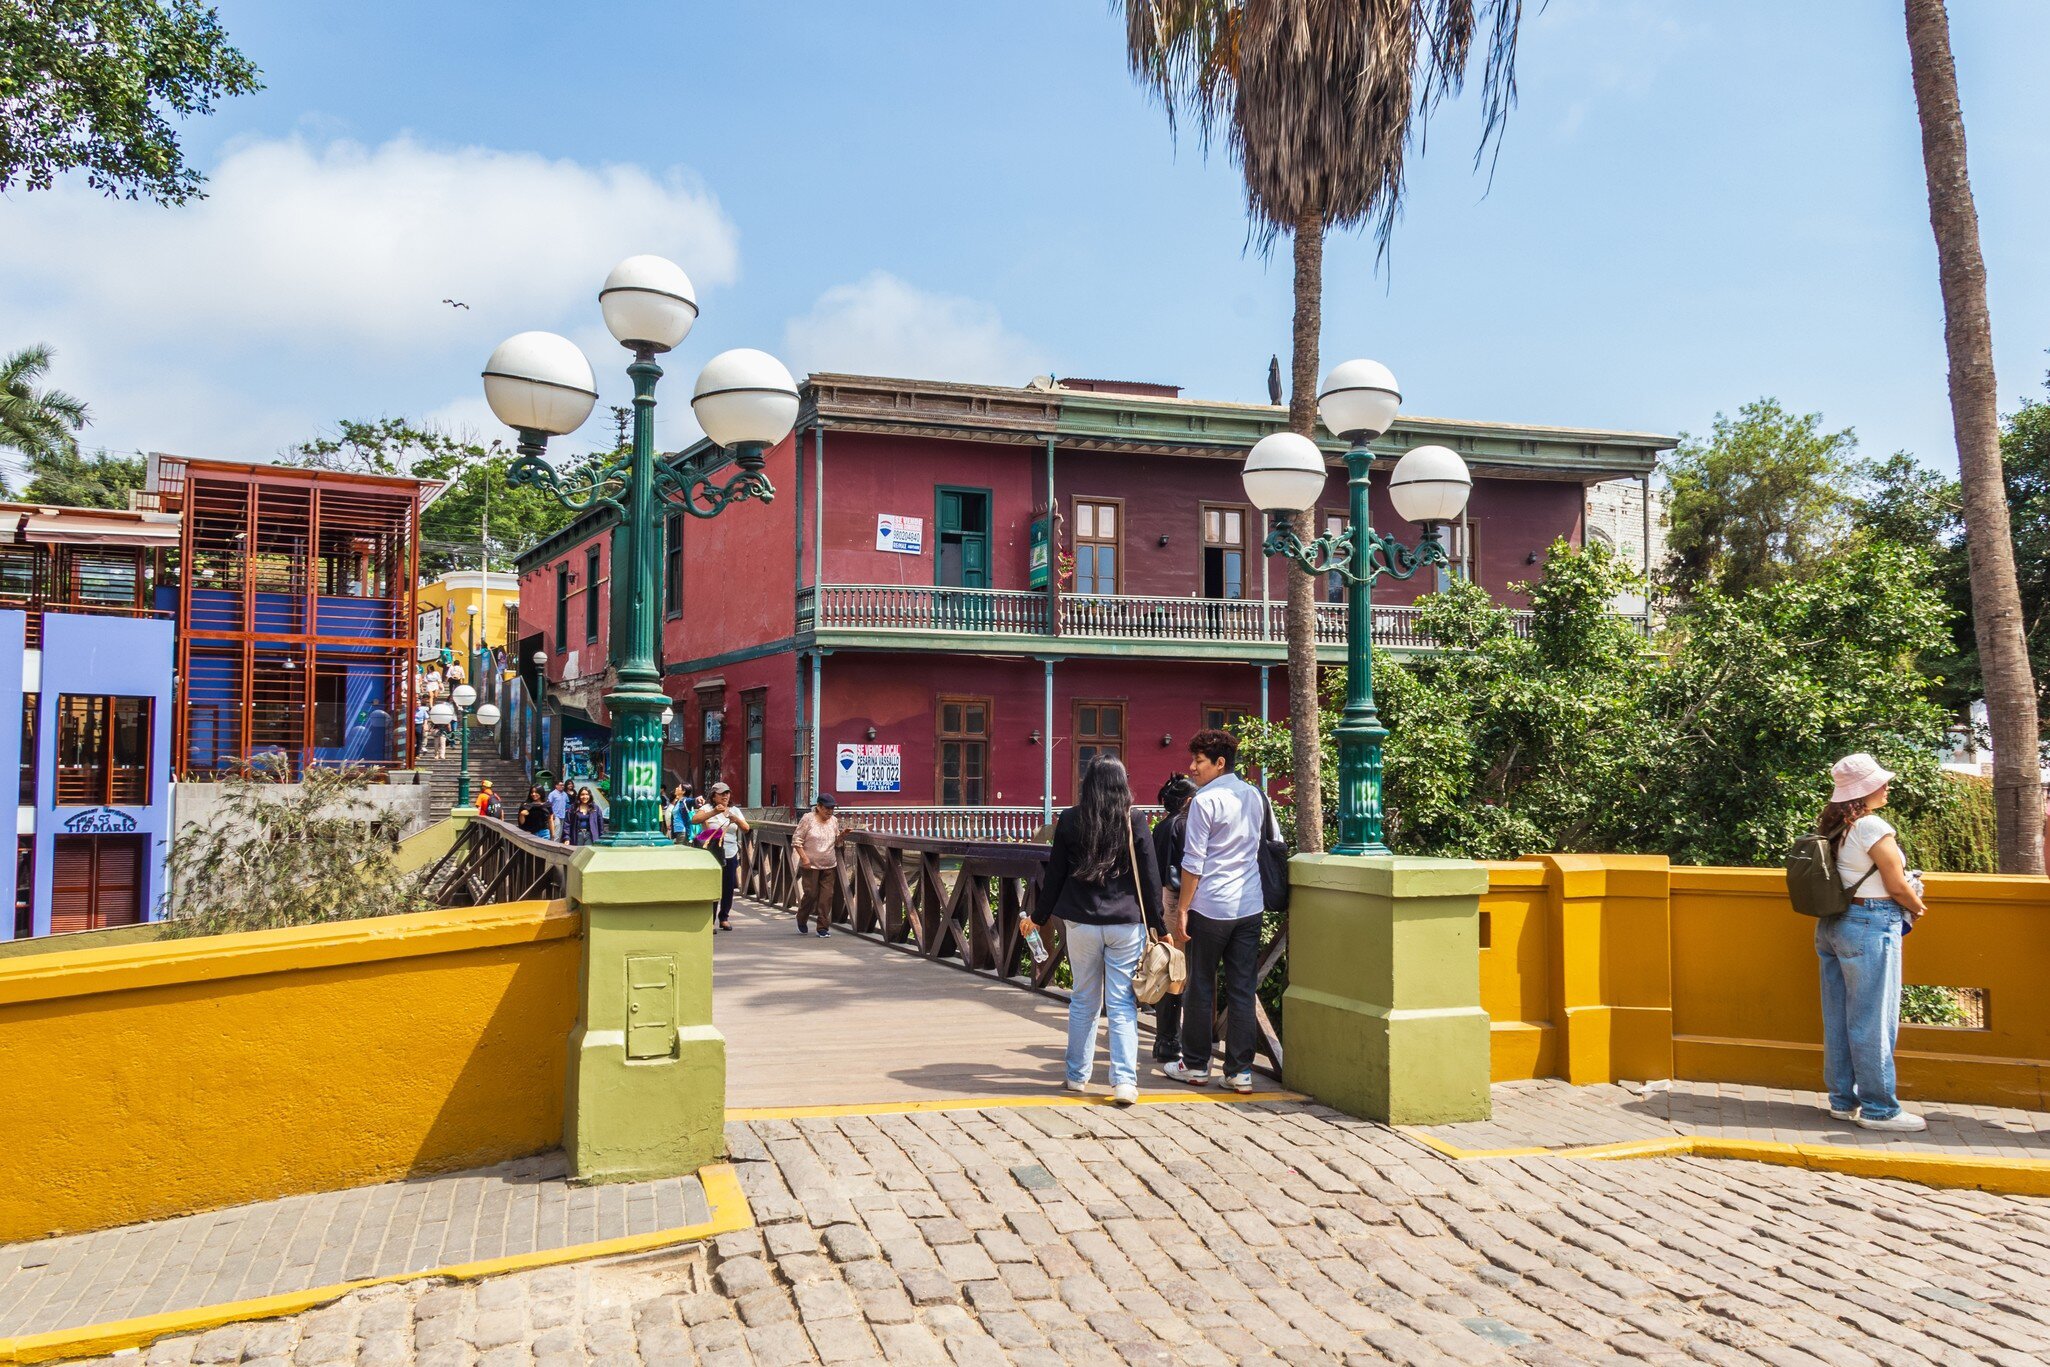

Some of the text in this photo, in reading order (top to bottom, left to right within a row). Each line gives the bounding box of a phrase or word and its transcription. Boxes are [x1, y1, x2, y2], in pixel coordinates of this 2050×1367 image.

[857, 745, 899, 756] SE VENDE LOCAL
[857, 756, 899, 766] CESARINA VASSALLO
[857, 766, 899, 781] 941 930 022
